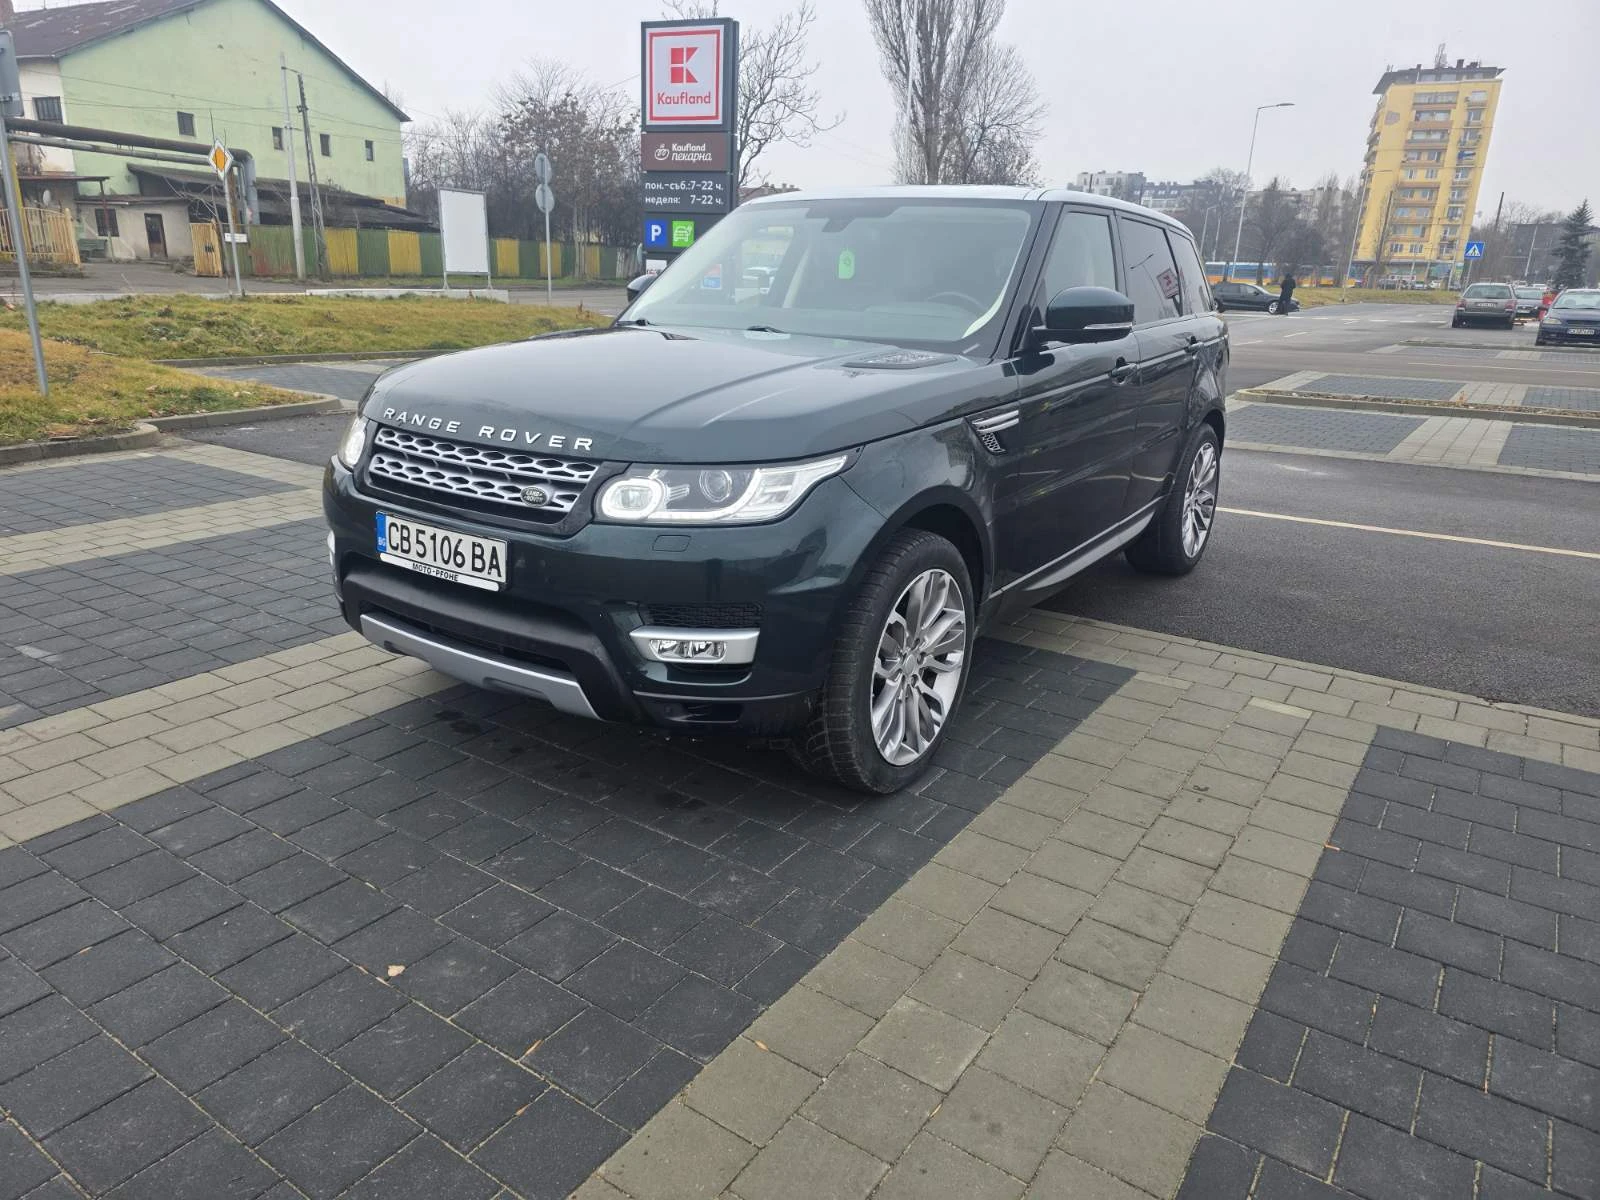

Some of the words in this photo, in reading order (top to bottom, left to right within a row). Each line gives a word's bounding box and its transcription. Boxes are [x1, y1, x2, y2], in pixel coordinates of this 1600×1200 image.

[657, 91, 711, 105] Kaufland
[671, 143, 706, 152] Kaufland
[671, 152, 712, 163] пекарна
[645, 196, 681, 206] неделя:
[690, 194, 713, 205] 7-22
[383, 407, 461, 433] RANGE
[478, 425, 593, 451] ROVER
[412, 562, 459, 582] MOTO-PFOHE
